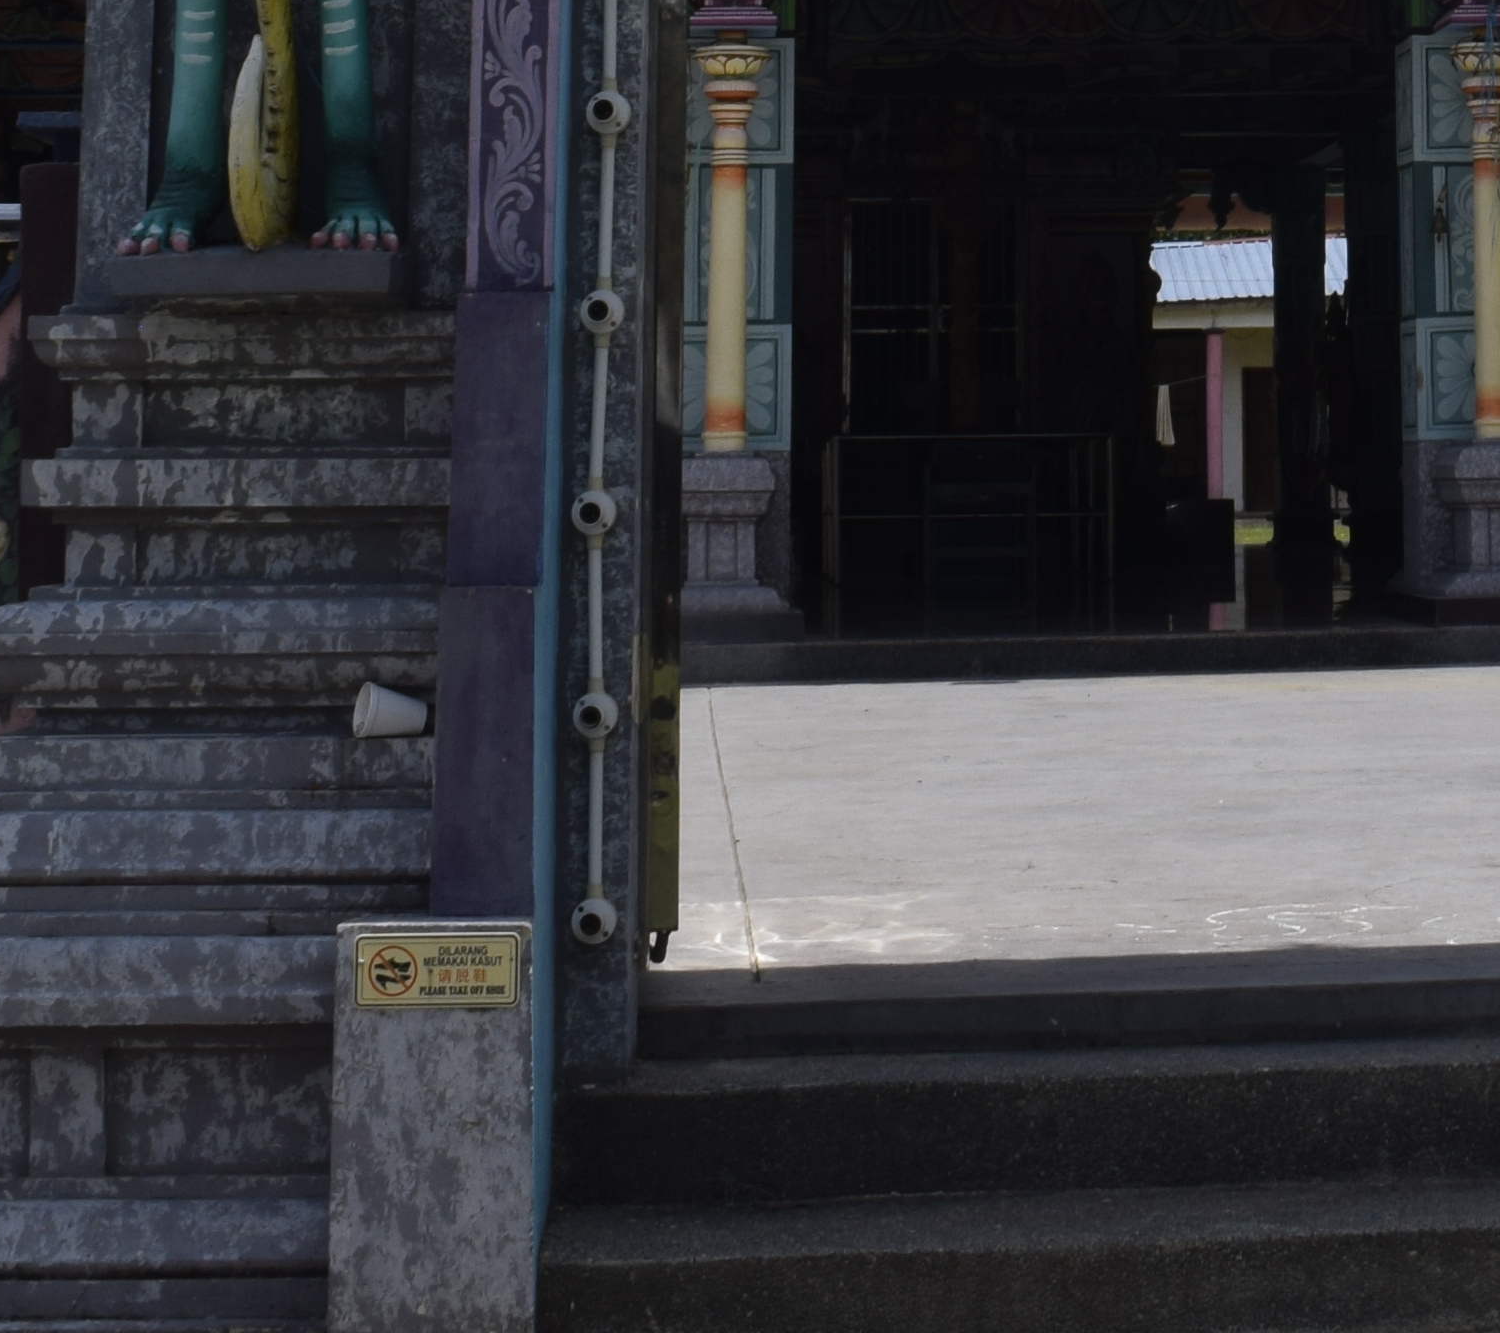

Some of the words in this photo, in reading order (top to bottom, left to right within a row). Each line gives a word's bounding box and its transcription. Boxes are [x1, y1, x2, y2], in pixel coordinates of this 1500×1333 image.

[439, 945, 488, 956] DILARANG
[423, 956, 468, 966] MEMAKAI
[470, 955, 503, 966] KASUT
[419, 986, 447, 995] PLEASE
[448, 986, 468, 995] TAKE
[470, 985, 484, 995] OFF
